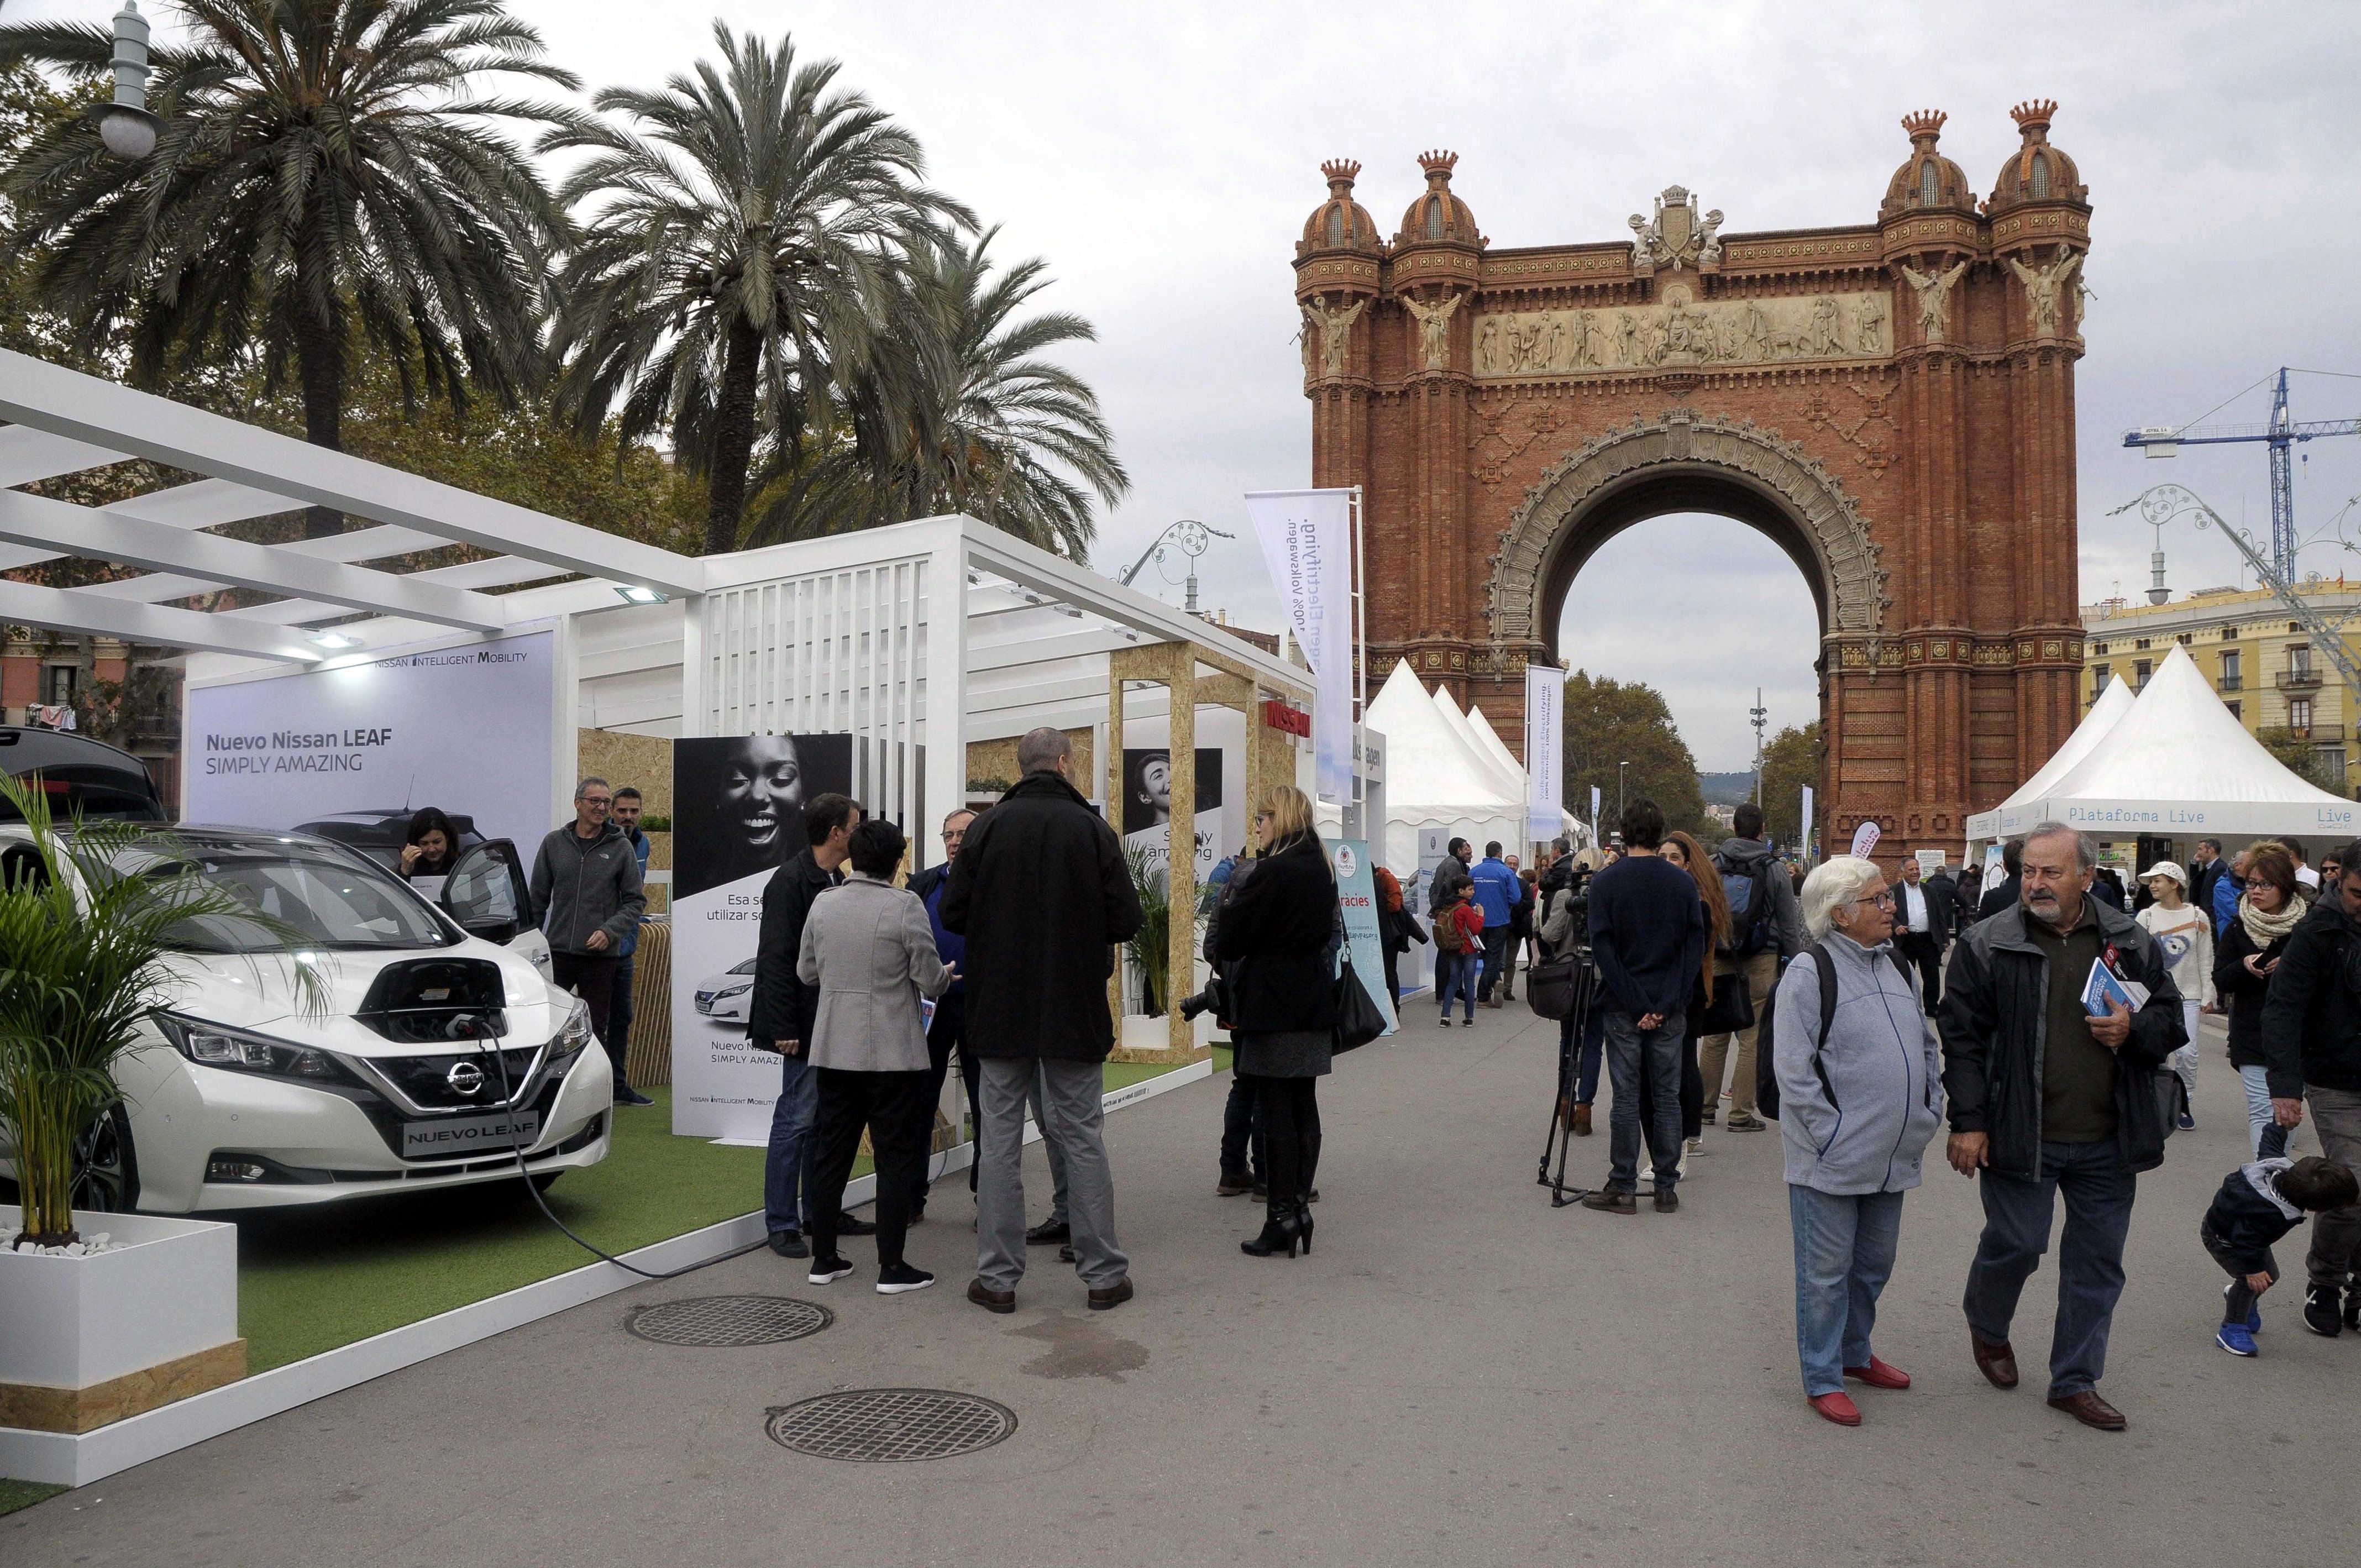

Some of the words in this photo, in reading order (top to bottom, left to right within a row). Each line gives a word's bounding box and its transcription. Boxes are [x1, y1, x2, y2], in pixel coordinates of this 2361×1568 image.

[376, 658, 407, 668] NISSAN
[478, 652, 527, 663] MOBILITY
[1267, 701, 1310, 738] NISSAN
[207, 735, 266, 751] Nuevo
[272, 731, 337, 748] Nissan
[344, 728, 392, 747] LEAF
[206, 757, 271, 774] SIMPLY
[275, 754, 362, 773] AMAZING
[2070, 807, 2159, 822] Plataforma
[2170, 810, 2204, 822] Live
[2318, 809, 2350, 821] Live
[728, 894, 749, 905] Esa
[1340, 893, 1369, 906] ràcies
[707, 909, 748, 921] utilizar
[711, 1041, 744, 1050] Nuevo
[711, 1055, 747, 1063] SIMPLY
[751, 1056, 781, 1065] AMAZI
[408, 1129, 478, 1144] NUEVO
[482, 1123, 534, 1136] LEAF
